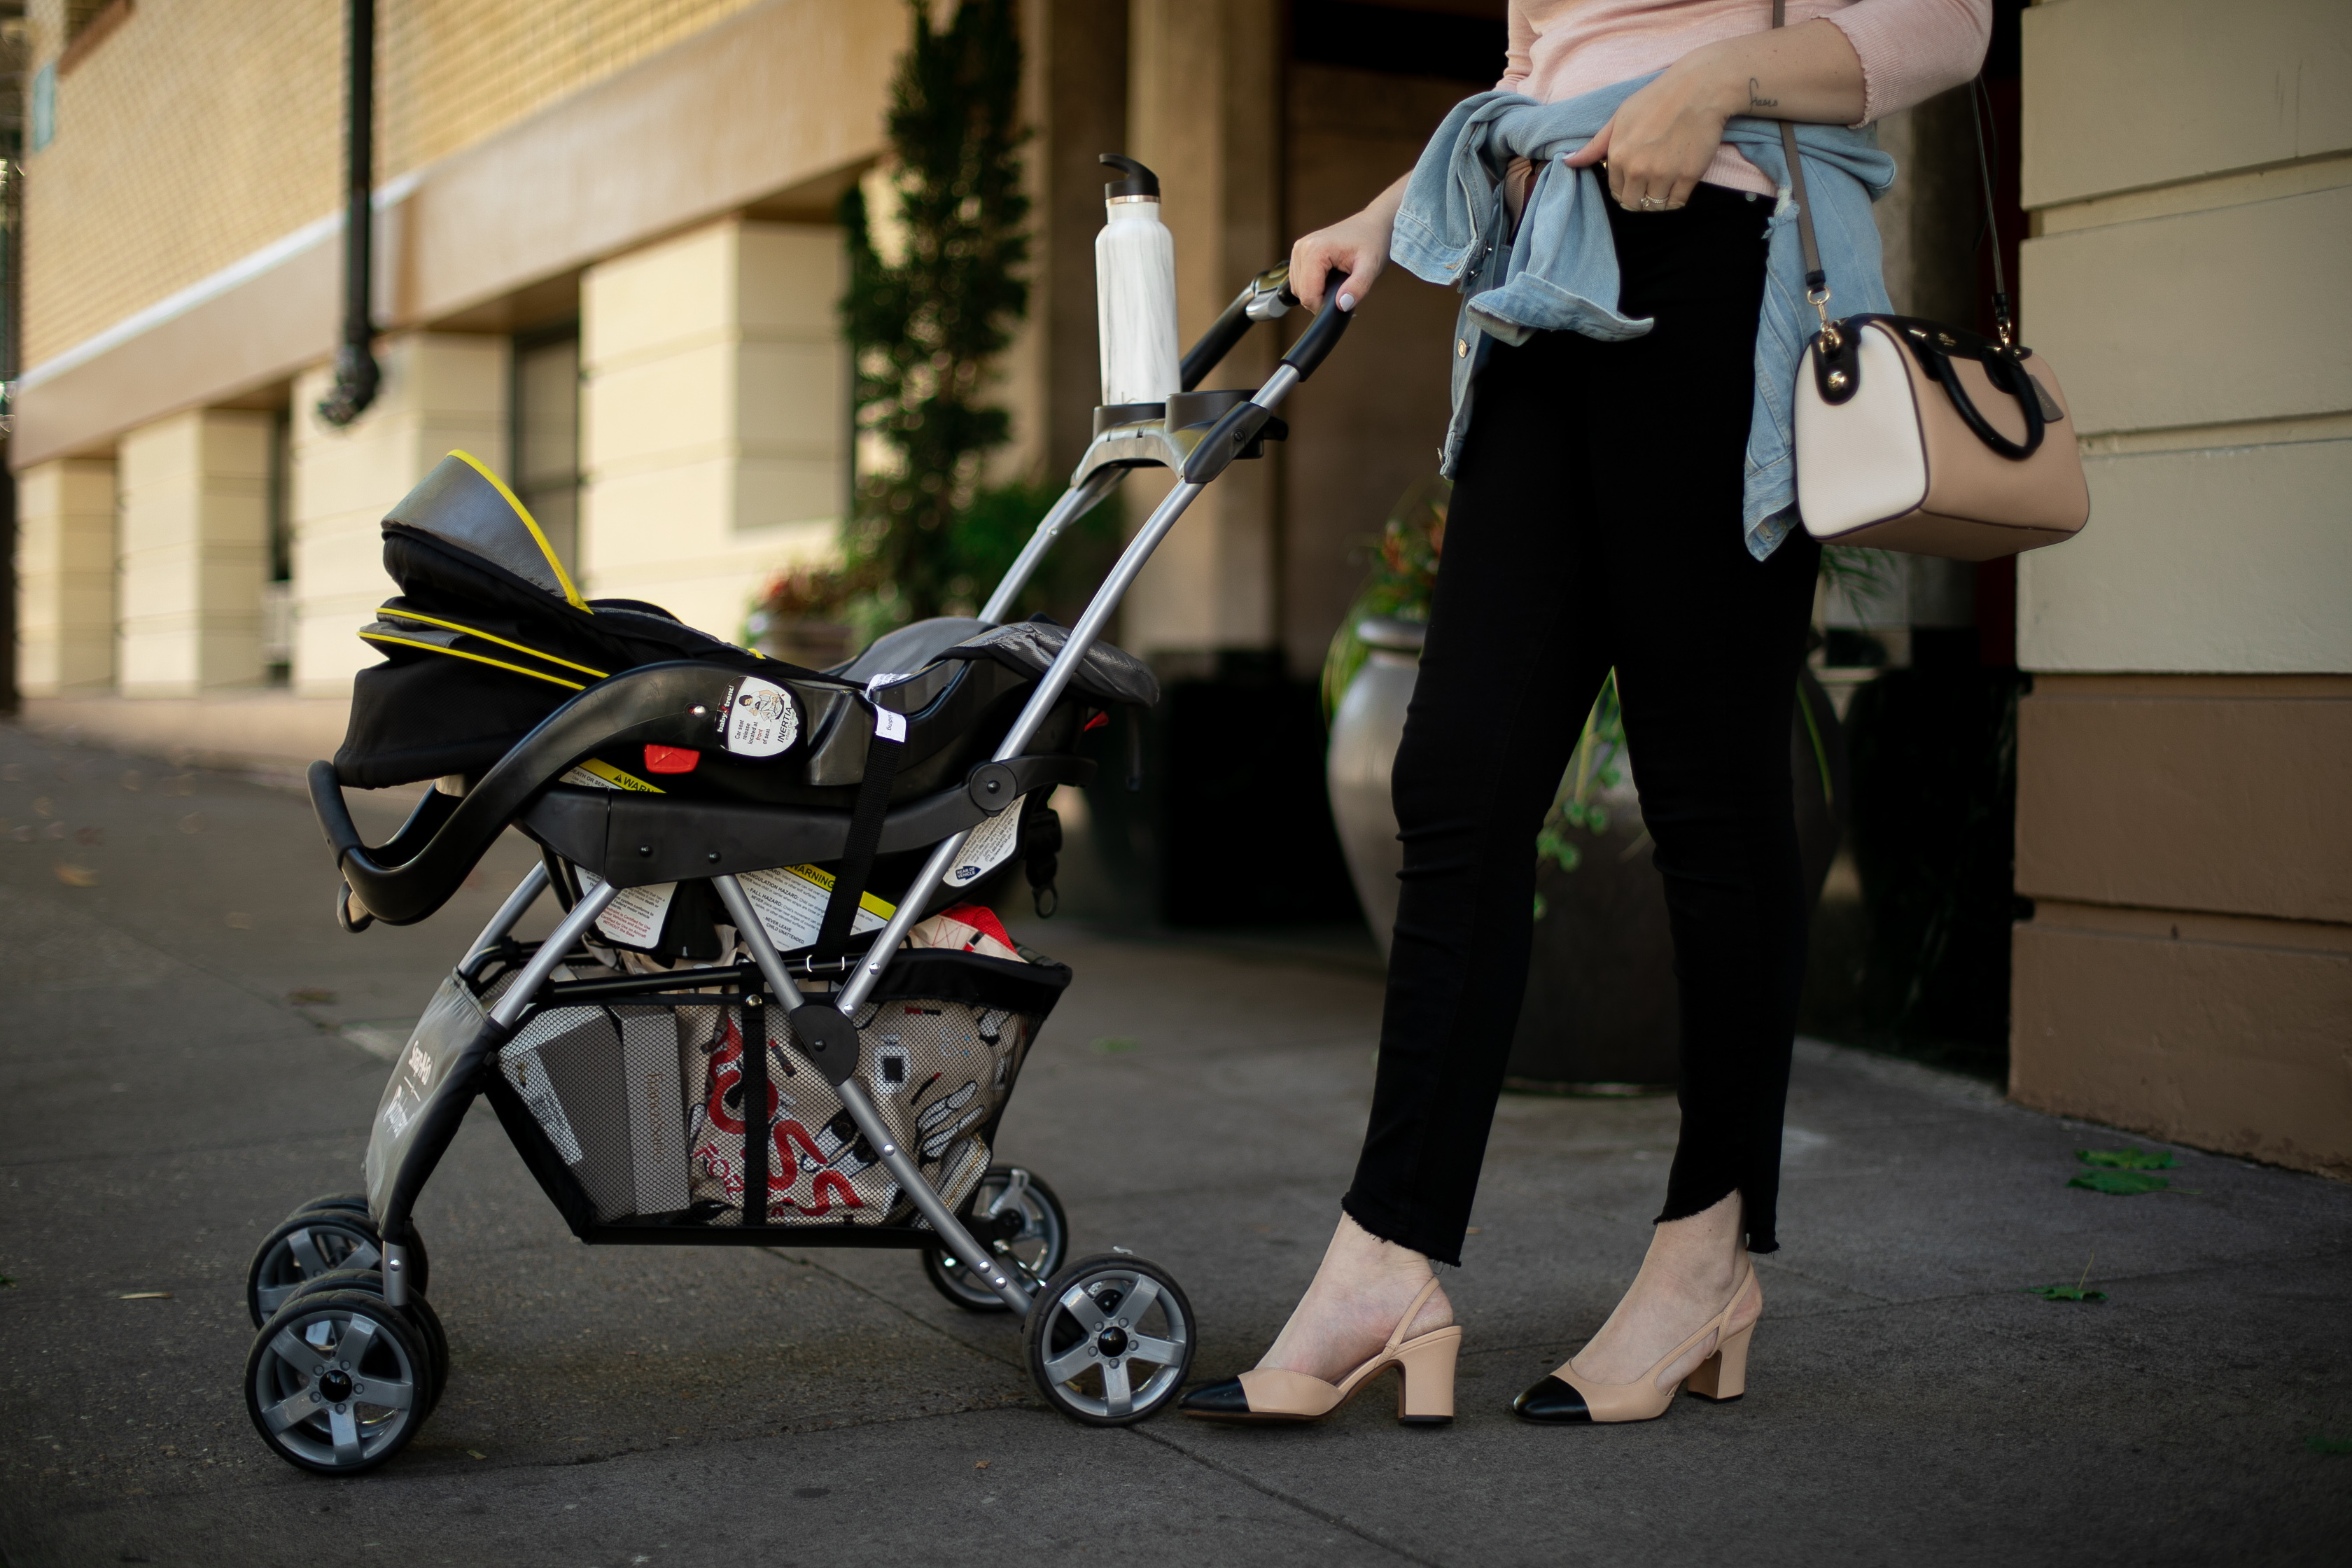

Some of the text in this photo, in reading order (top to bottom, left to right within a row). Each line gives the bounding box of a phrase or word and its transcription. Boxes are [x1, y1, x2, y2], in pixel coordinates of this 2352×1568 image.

[717, 712, 728, 733] baby
[741, 722, 750, 740] release
[776, 706, 793, 743] INERTIA
[747, 727, 757, 745] located
[739, 874, 752, 883] NEVER
[957, 870, 975, 878] VEHICLE
[634, 888, 645, 897] inflates
[778, 886, 799, 900] HAZARD:
[613, 899, 626, 907] Federal
[637, 911, 650, 919] vehicle
[620, 898, 634, 906] system
[633, 904, 650, 914] conforms
[749, 888, 762, 897] FALL
[761, 893, 783, 907] HAZARD:
[793, 911, 810, 921] movement
[750, 894, 764, 903] NEVER
[804, 921, 816, 930] counter
[600, 913, 615, 923] Certified
[633, 930, 646, 938] Aircraft
[602, 919, 620, 930] WITHOUT
[612, 913, 627, 923] Vehicles
[634, 924, 648, 932] Aircraft
[623, 914, 638, 924] Certified
[764, 916, 792, 932] NEVER LEAVE
[778, 913, 792, 923] elevated
[791, 920, 806, 930] surfaces.
[765, 922, 778, 932] CHILD
[778, 928, 805, 944] UNATTENDED.
